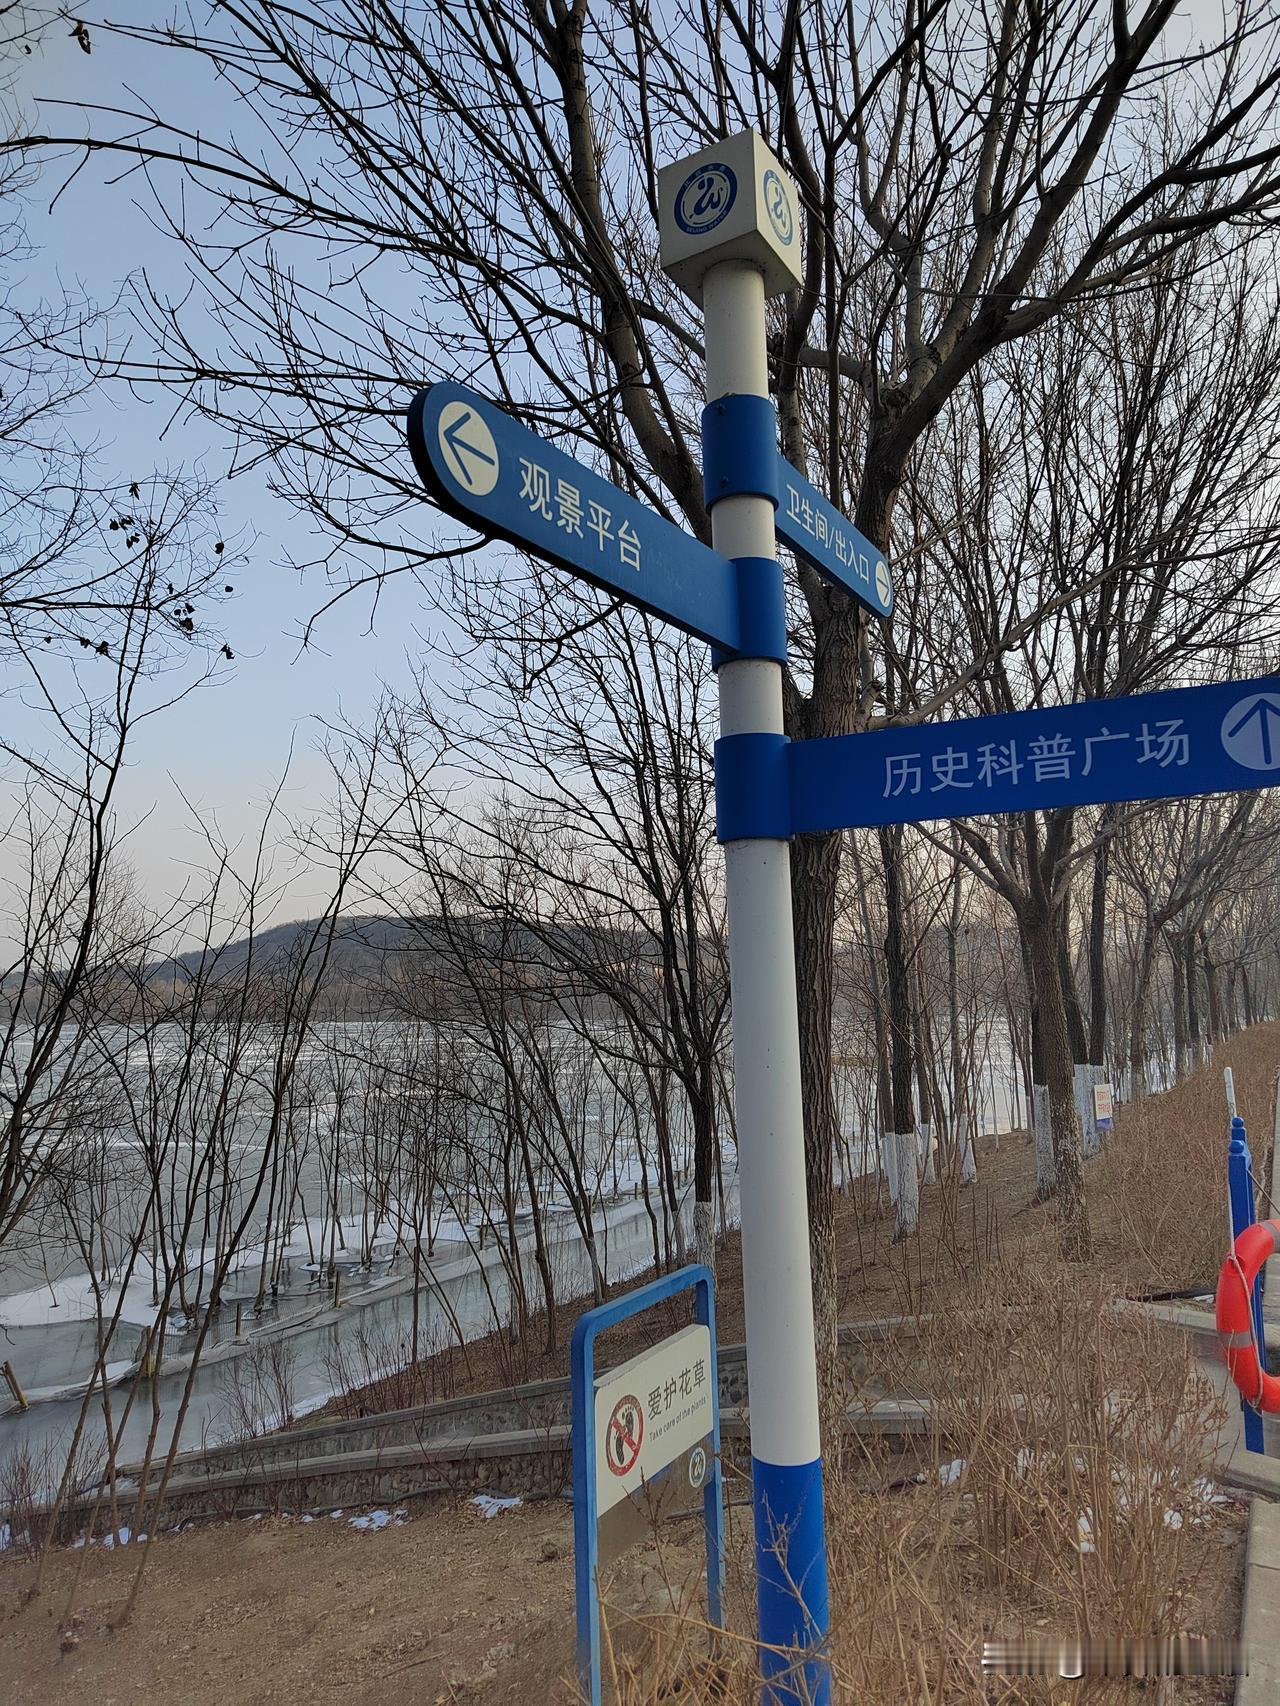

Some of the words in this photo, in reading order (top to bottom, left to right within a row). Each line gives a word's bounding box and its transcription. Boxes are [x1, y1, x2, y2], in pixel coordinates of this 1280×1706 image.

[518, 457, 642, 572] 观景平台
[786, 483, 870, 585] 卫生间/出入口
[882, 718, 1190, 798] 历史科普广场
[648, 1359, 706, 1420] 爱护花草
[649, 1426, 663, 1441] Take
[663, 1419, 675, 1432] care
[676, 1411, 682, 1424] of
[682, 1407, 691, 1420] the
[691, 1396, 706, 1415] plants
